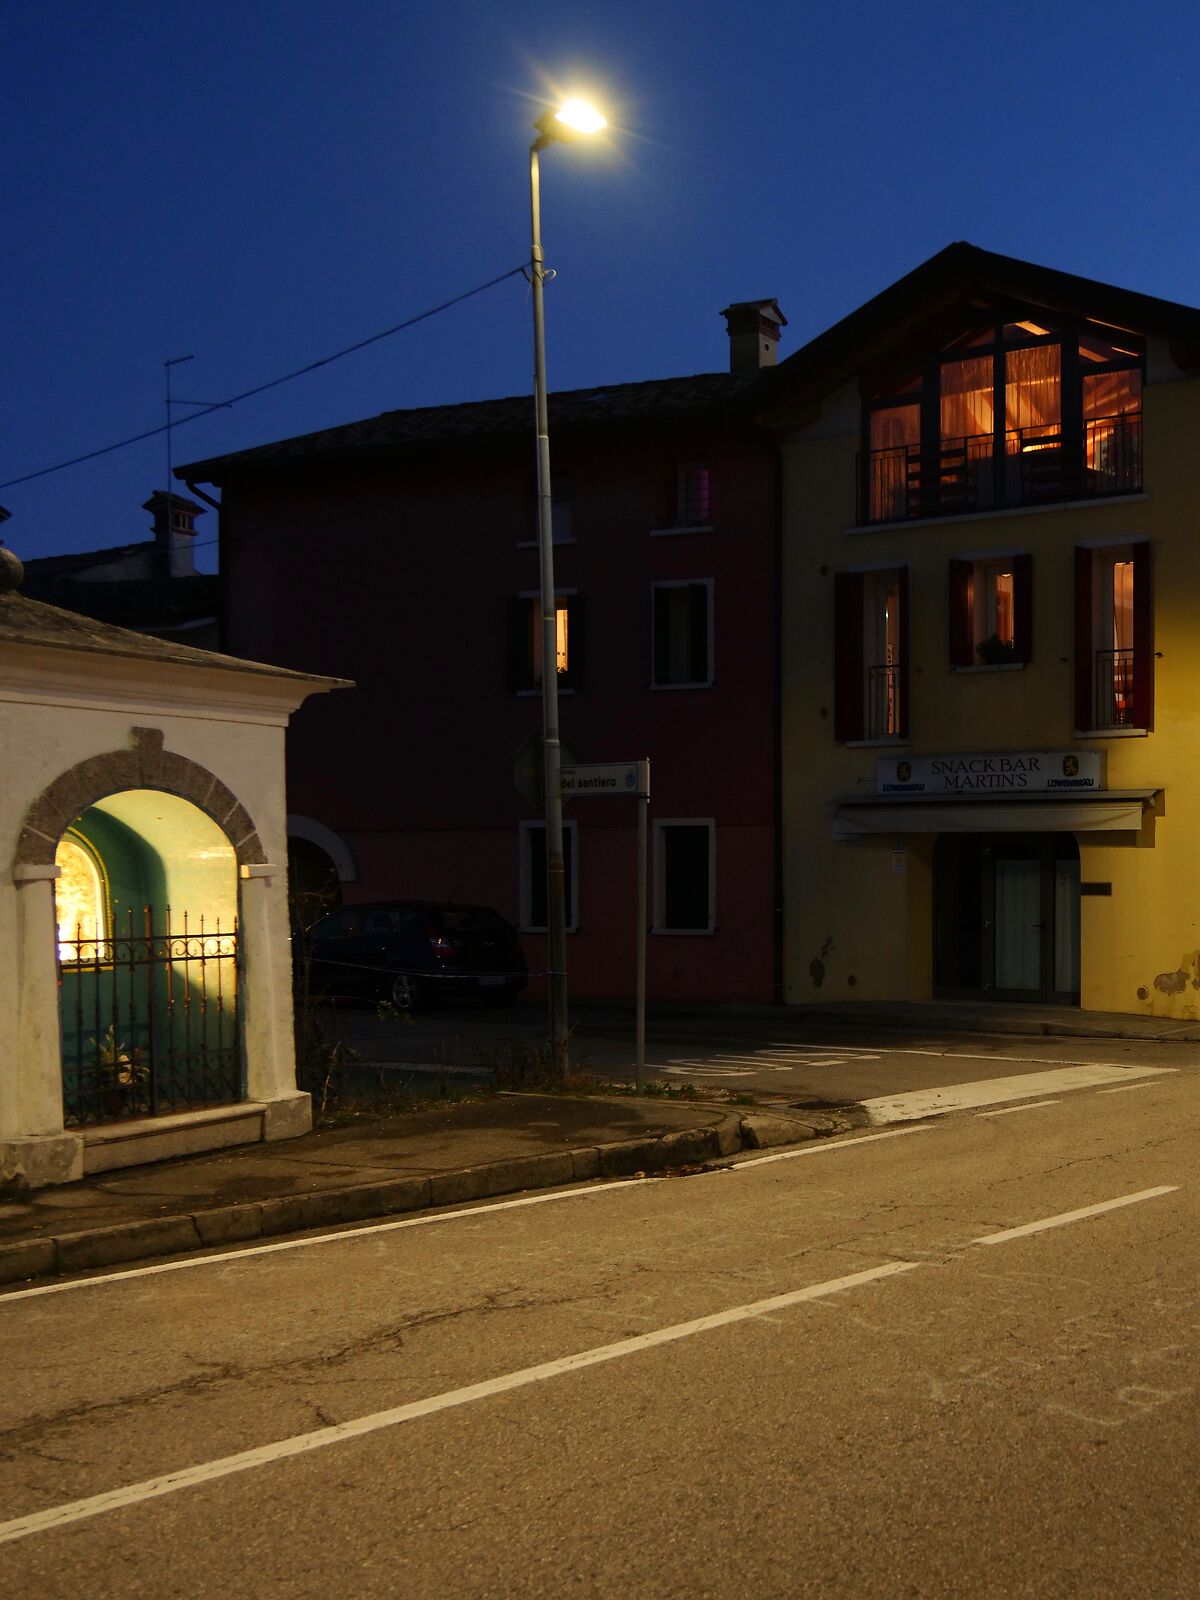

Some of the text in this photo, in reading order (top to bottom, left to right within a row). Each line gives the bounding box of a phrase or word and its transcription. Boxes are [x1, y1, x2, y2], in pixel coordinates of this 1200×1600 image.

[931, 756, 1042, 775] SNACK BAR
[560, 775, 617, 789] del sentiero
[944, 772, 1028, 791] MARTIN'S
